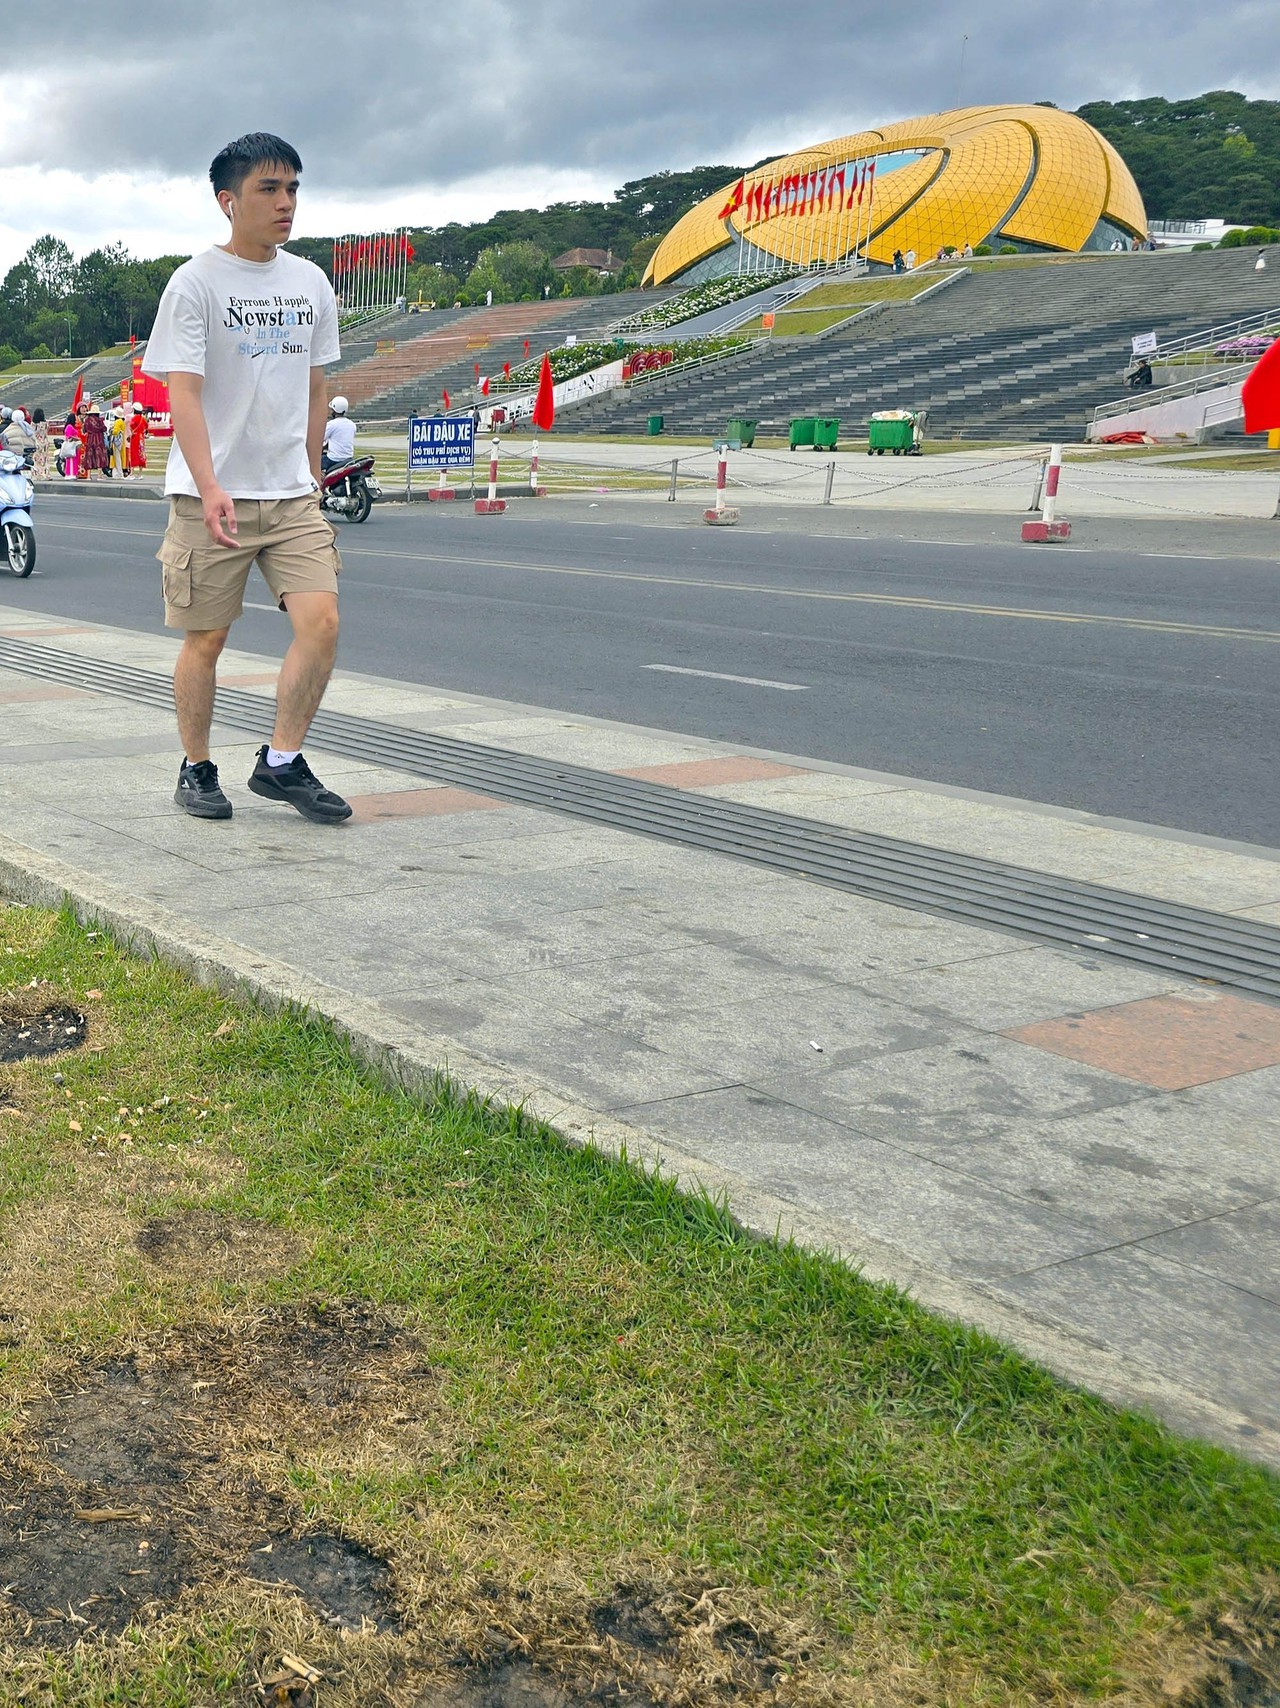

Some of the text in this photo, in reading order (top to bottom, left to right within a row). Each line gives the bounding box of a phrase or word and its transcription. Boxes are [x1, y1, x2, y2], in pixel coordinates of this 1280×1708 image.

[256, 327, 290, 339] In The
[413, 421, 471, 445] BÃI ĐẬU XE
[412, 446, 422, 457] (CÓ
[423, 447, 435, 456] THU
